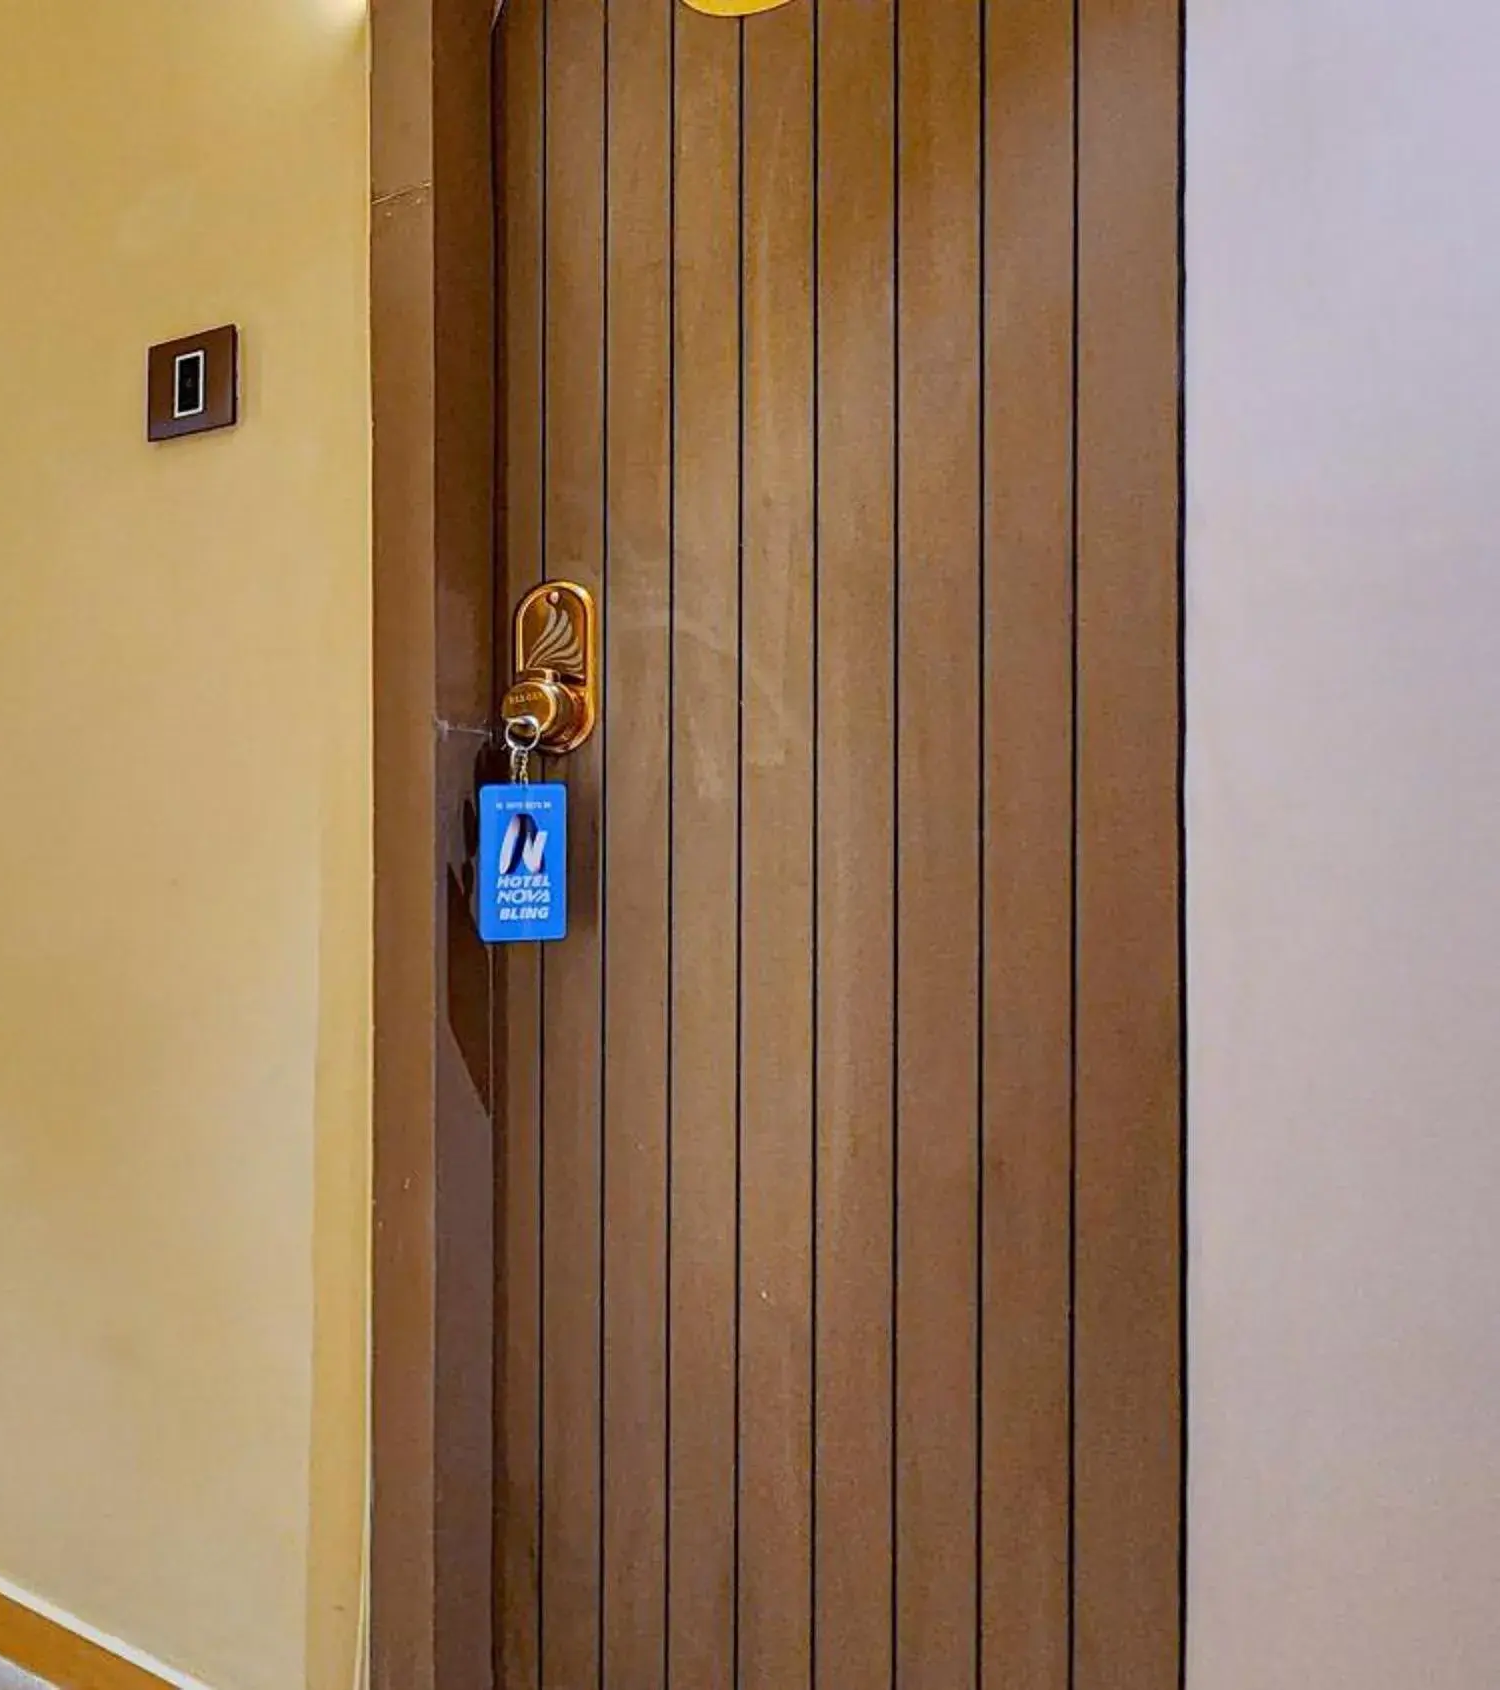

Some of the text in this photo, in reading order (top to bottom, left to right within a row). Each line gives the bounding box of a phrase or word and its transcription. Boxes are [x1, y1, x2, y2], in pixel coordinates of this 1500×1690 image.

[496, 875, 551, 888] HOTEL
[497, 889, 551, 904] NOVA
[499, 907, 549, 920] BLING
